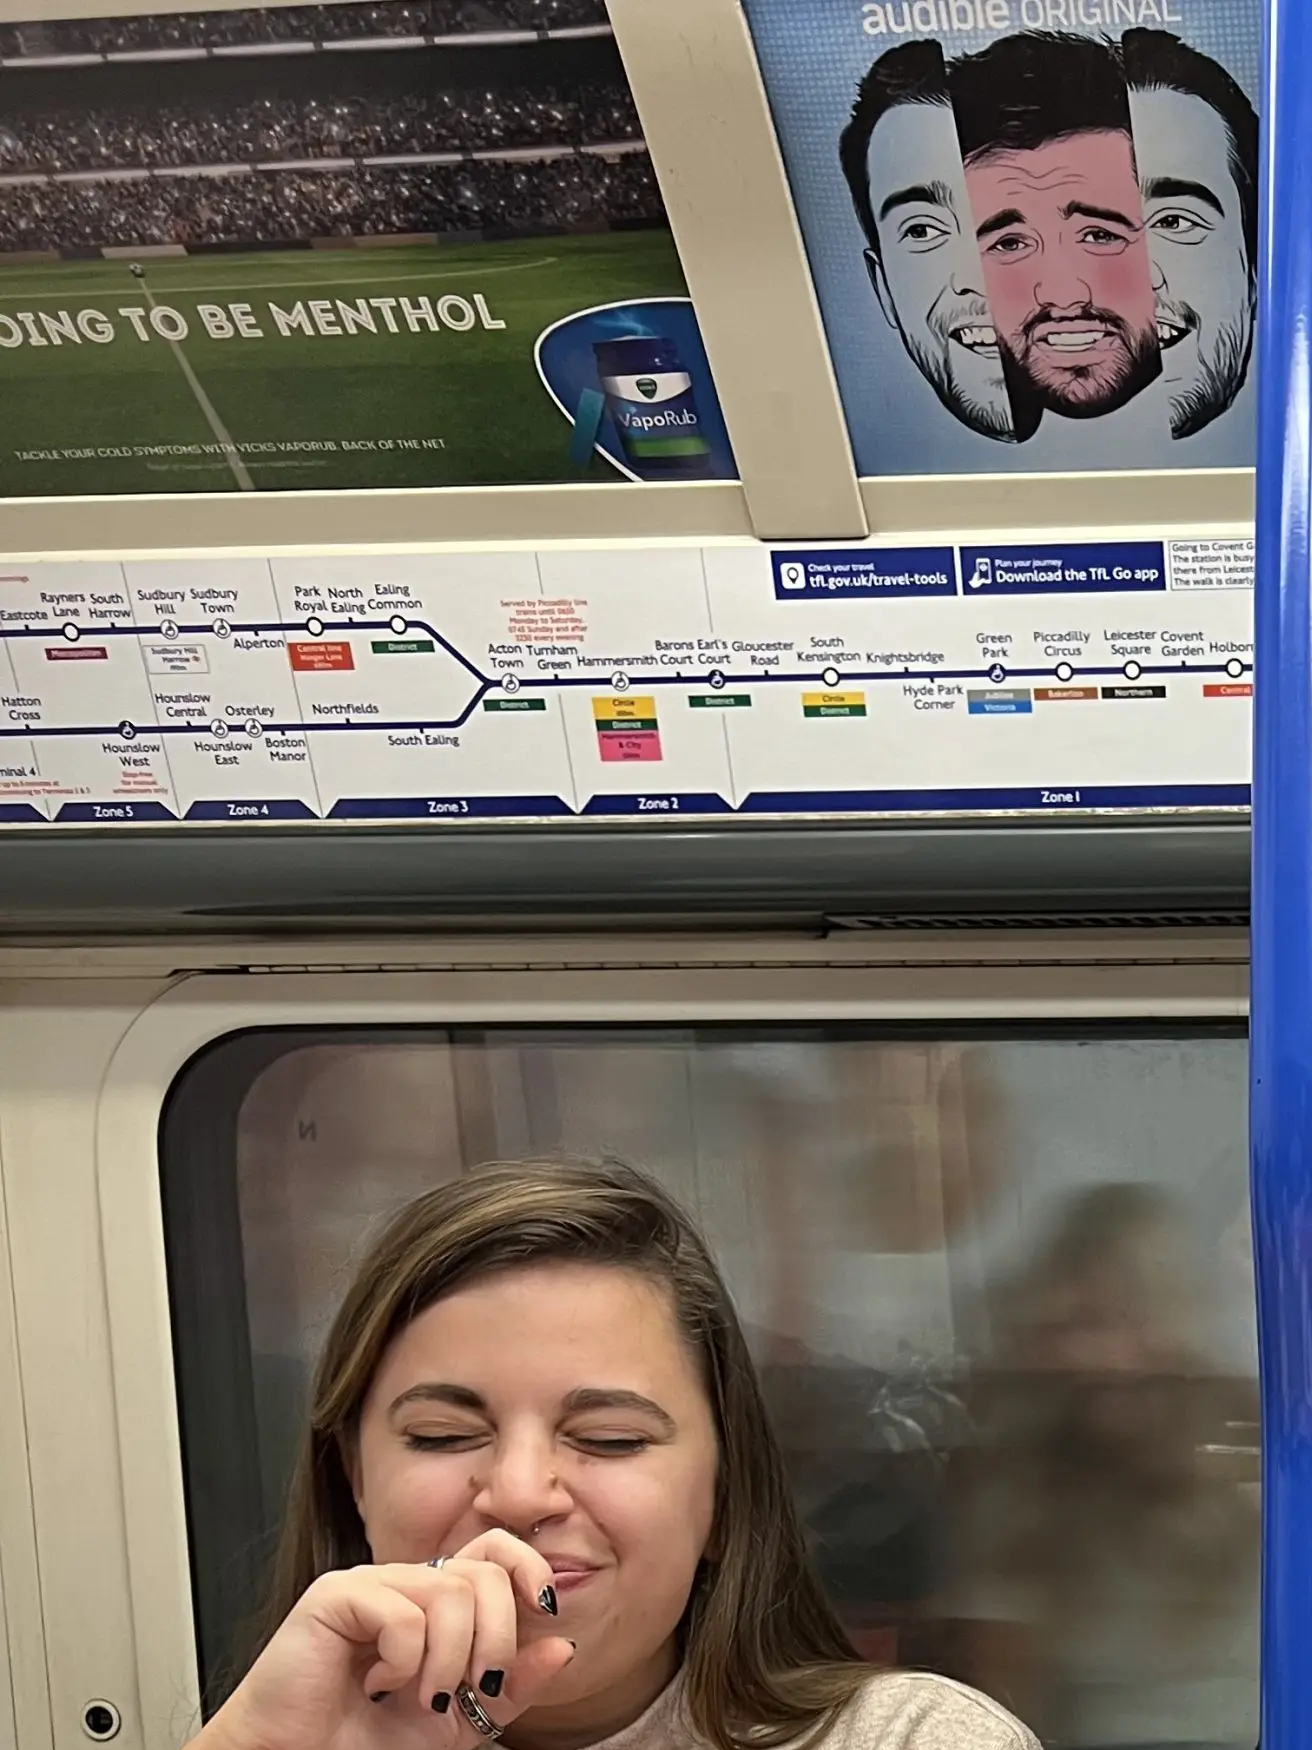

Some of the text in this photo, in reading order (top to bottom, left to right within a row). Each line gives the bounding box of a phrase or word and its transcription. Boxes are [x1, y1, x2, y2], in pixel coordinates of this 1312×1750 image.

[862, 0, 1182, 35] audible ORIGINAL
[119, 306, 189, 342] TO
[196, 303, 264, 339] BE
[268, 293, 507, 337] MENTHOL
[618, 409, 698, 431] VapoRub
[15, 450, 60, 461] TACKLE
[61, 448, 97, 459] YOUR
[97, 447, 132, 457] COLD
[133, 445, 200, 456] SYMPTOMS
[201, 443, 236, 454] WITH
[236, 442, 277, 453] VICKS
[342, 439, 377, 450] BACK
[378, 439, 394, 450] OF
[395, 438, 418, 450] THE
[419, 438, 445, 449] NET
[808, 562, 875, 574] Check your travel
[995, 558, 1063, 569] Plan your journey
[809, 572, 948, 589] tfl.gov.uk/travel-tools
[995, 567, 1160, 584] Download the TfL Go app
[810, 636, 844, 648] South
[976, 632, 1013, 645] Green
[1033, 631, 1091, 645] Piccadilly
[1103, 629, 1157, 642] Leicester
[1160, 631, 1204, 643] Covent
[233, 637, 285, 651] Alperton
[488, 644, 523, 656] Acton
[697, 639, 728, 651] Earl's
[1044, 644, 1082, 657] Circus
[1110, 643, 1152, 658] Square
[797, 650, 861, 665] Kensington
[981, 647, 1009, 658] Park
[1161, 645, 1205, 657] Garden
[491, 657, 525, 669] Town
[577, 655, 658, 667] Hammersmith
[697, 653, 731, 666] Court
[866, 651, 945, 666] Knightsbridge
[902, 684, 964, 698] Hyde Park
[312, 702, 379, 716] Northfields
[914, 698, 956, 711] Corner
[225, 705, 275, 718] Osterley
[388, 733, 460, 748] South Ealing
[227, 804, 269, 817] Zone 4
